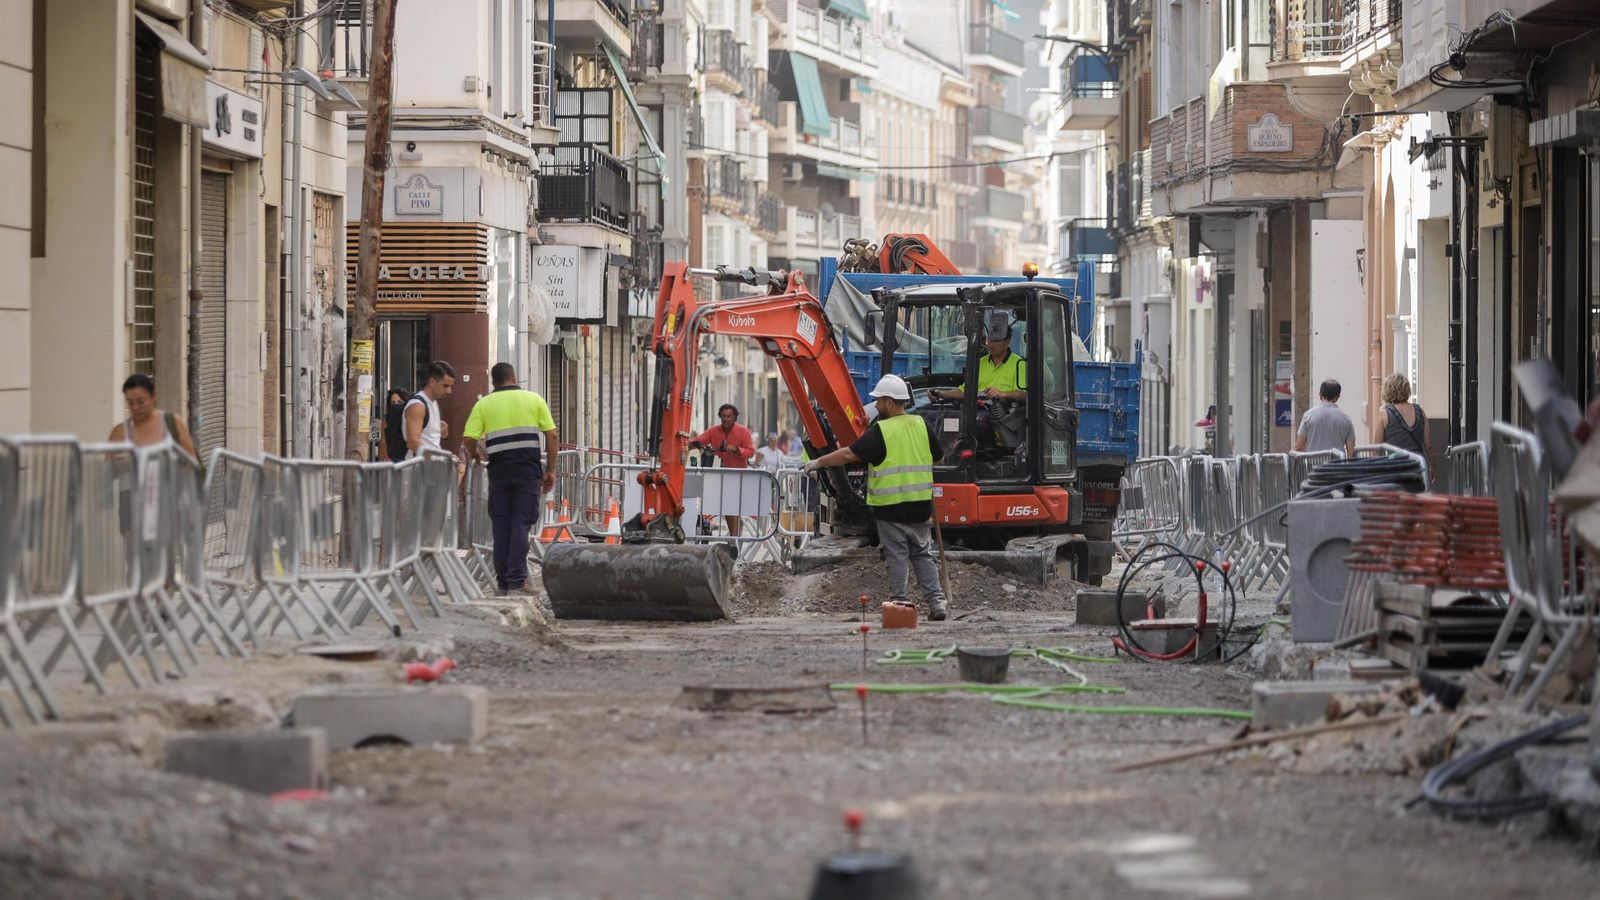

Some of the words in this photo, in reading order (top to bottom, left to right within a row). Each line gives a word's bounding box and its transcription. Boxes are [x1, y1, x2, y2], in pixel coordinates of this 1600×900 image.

[408, 191, 431, 199] CALLE
[410, 199, 431, 209] PINO
[536, 254, 575, 268] UÑAS
[408, 263, 466, 281] OLEA
[545, 273, 565, 286] Sin
[547, 285, 566, 297] ita
[728, 314, 755, 327] Kubota
[799, 311, 817, 336] SUS
[1052, 442, 1066, 457] SUS
[1006, 505, 1040, 517] U56-5
